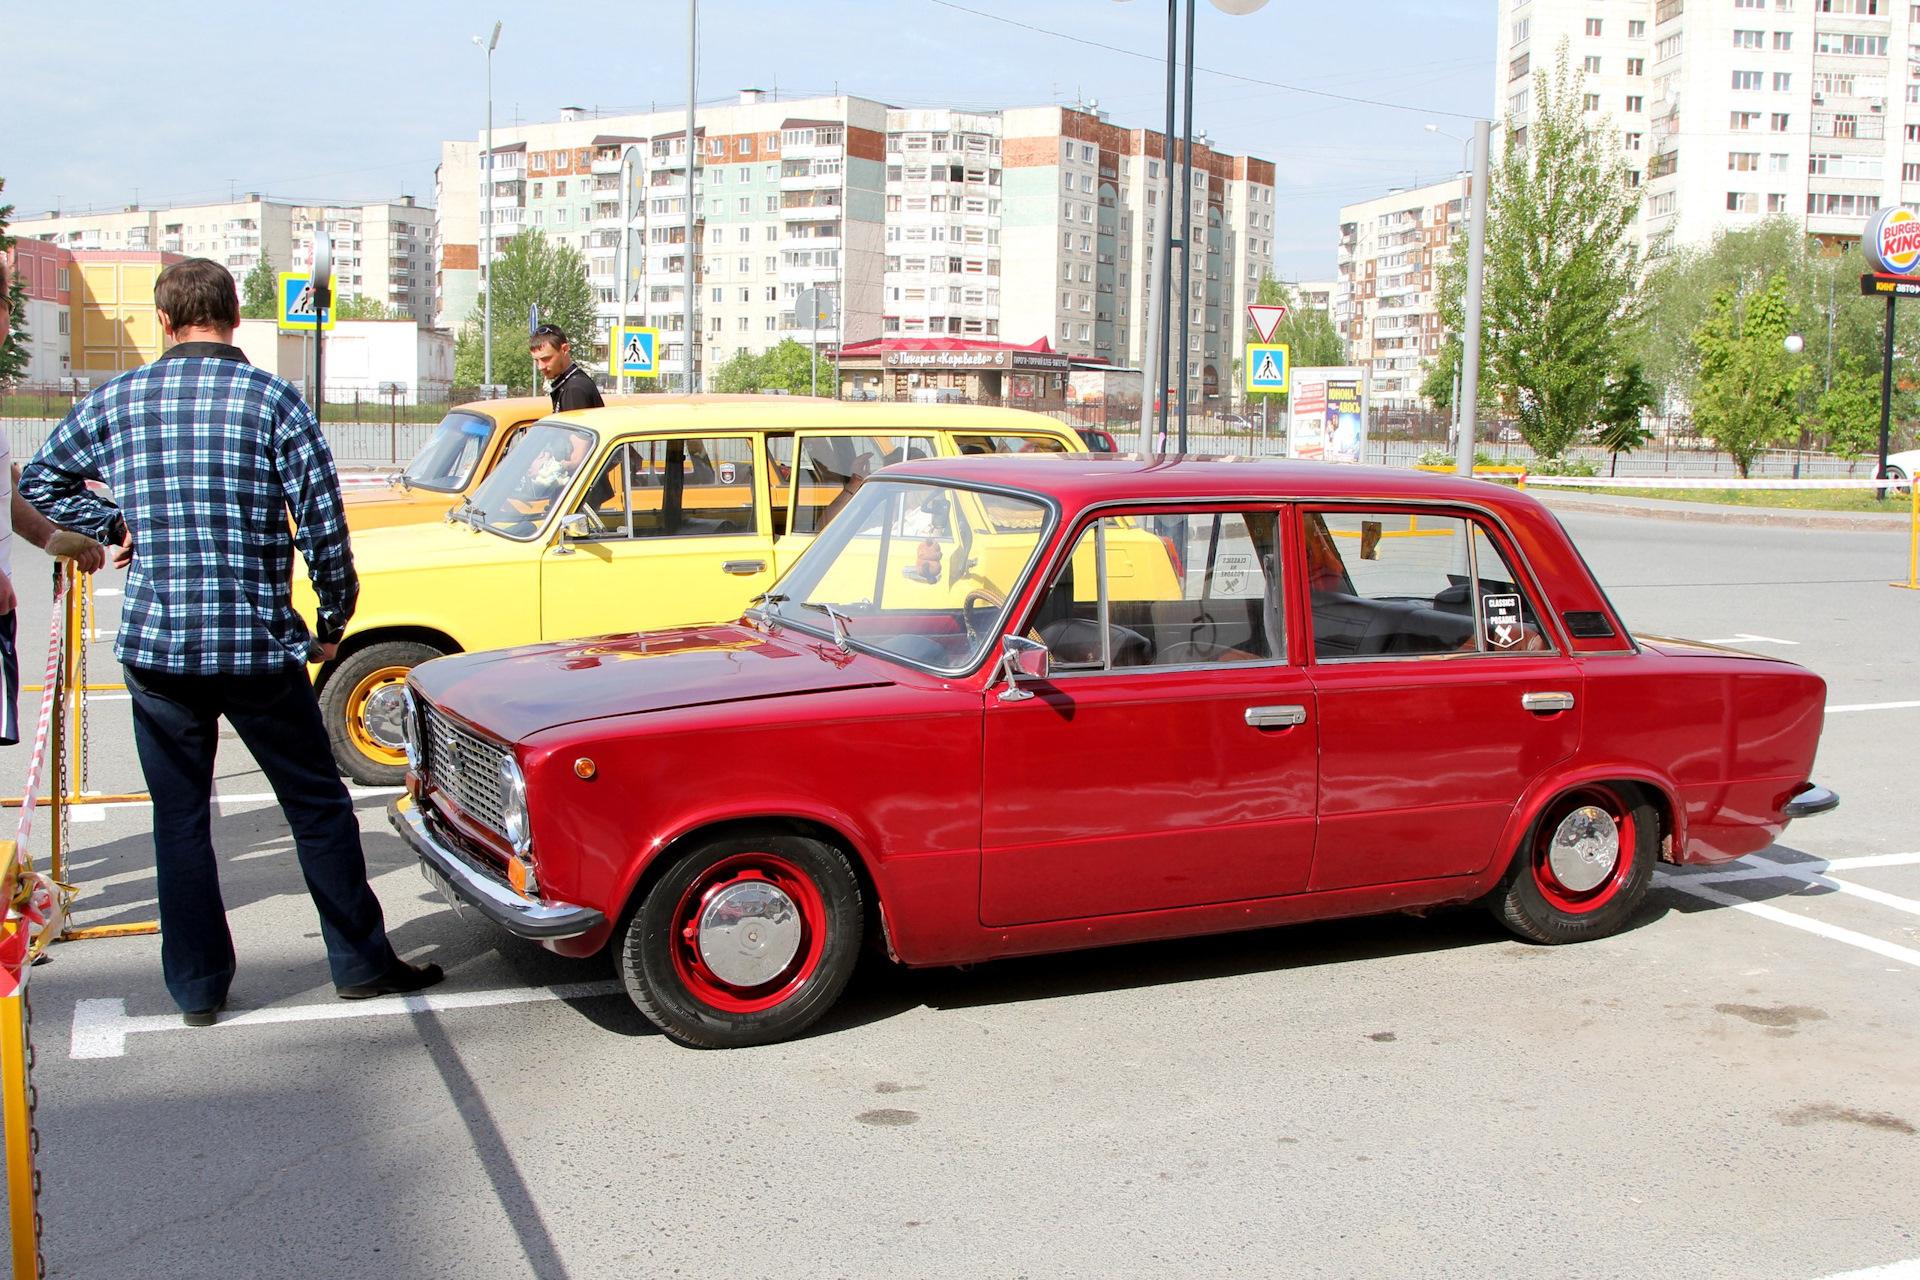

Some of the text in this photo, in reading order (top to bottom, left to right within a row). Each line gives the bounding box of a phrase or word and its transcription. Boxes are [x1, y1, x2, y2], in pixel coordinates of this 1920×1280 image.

[1883, 222, 1920, 240] BURGER
[1883, 233, 1920, 257] KING
[1876, 281, 1896, 291] КИНГ
[1488, 598, 1515, 608] CLASSICS
